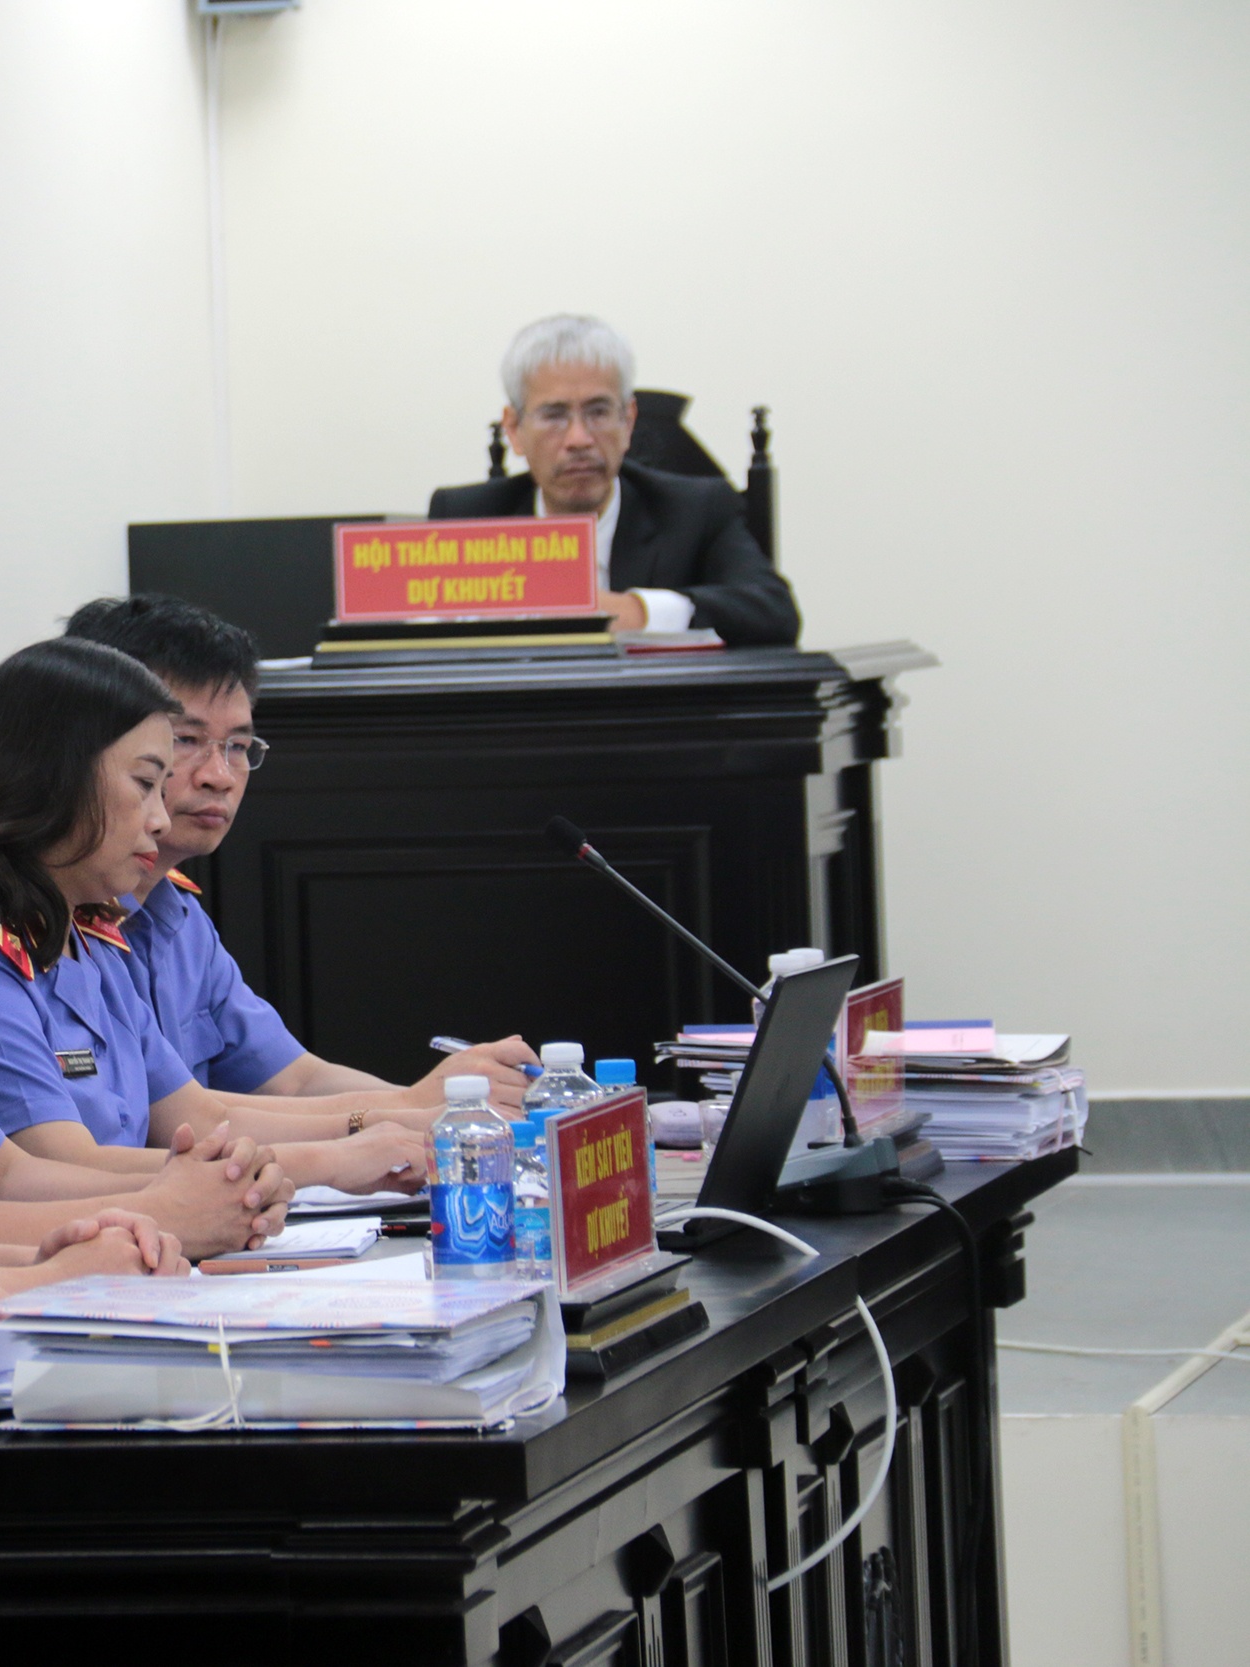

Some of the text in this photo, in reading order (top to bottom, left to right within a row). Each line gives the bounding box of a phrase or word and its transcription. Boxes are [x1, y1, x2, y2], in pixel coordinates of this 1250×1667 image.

[353, 538, 391, 573] HỘI
[465, 533, 526, 564] NHÂN
[533, 530, 578, 561] DÂN
[408, 568, 526, 608] DỰ KHUYẾT
[575, 1123, 633, 1189] KIỂM SÁT VIÊN
[599, 1185, 629, 1248] KHUYẾT
